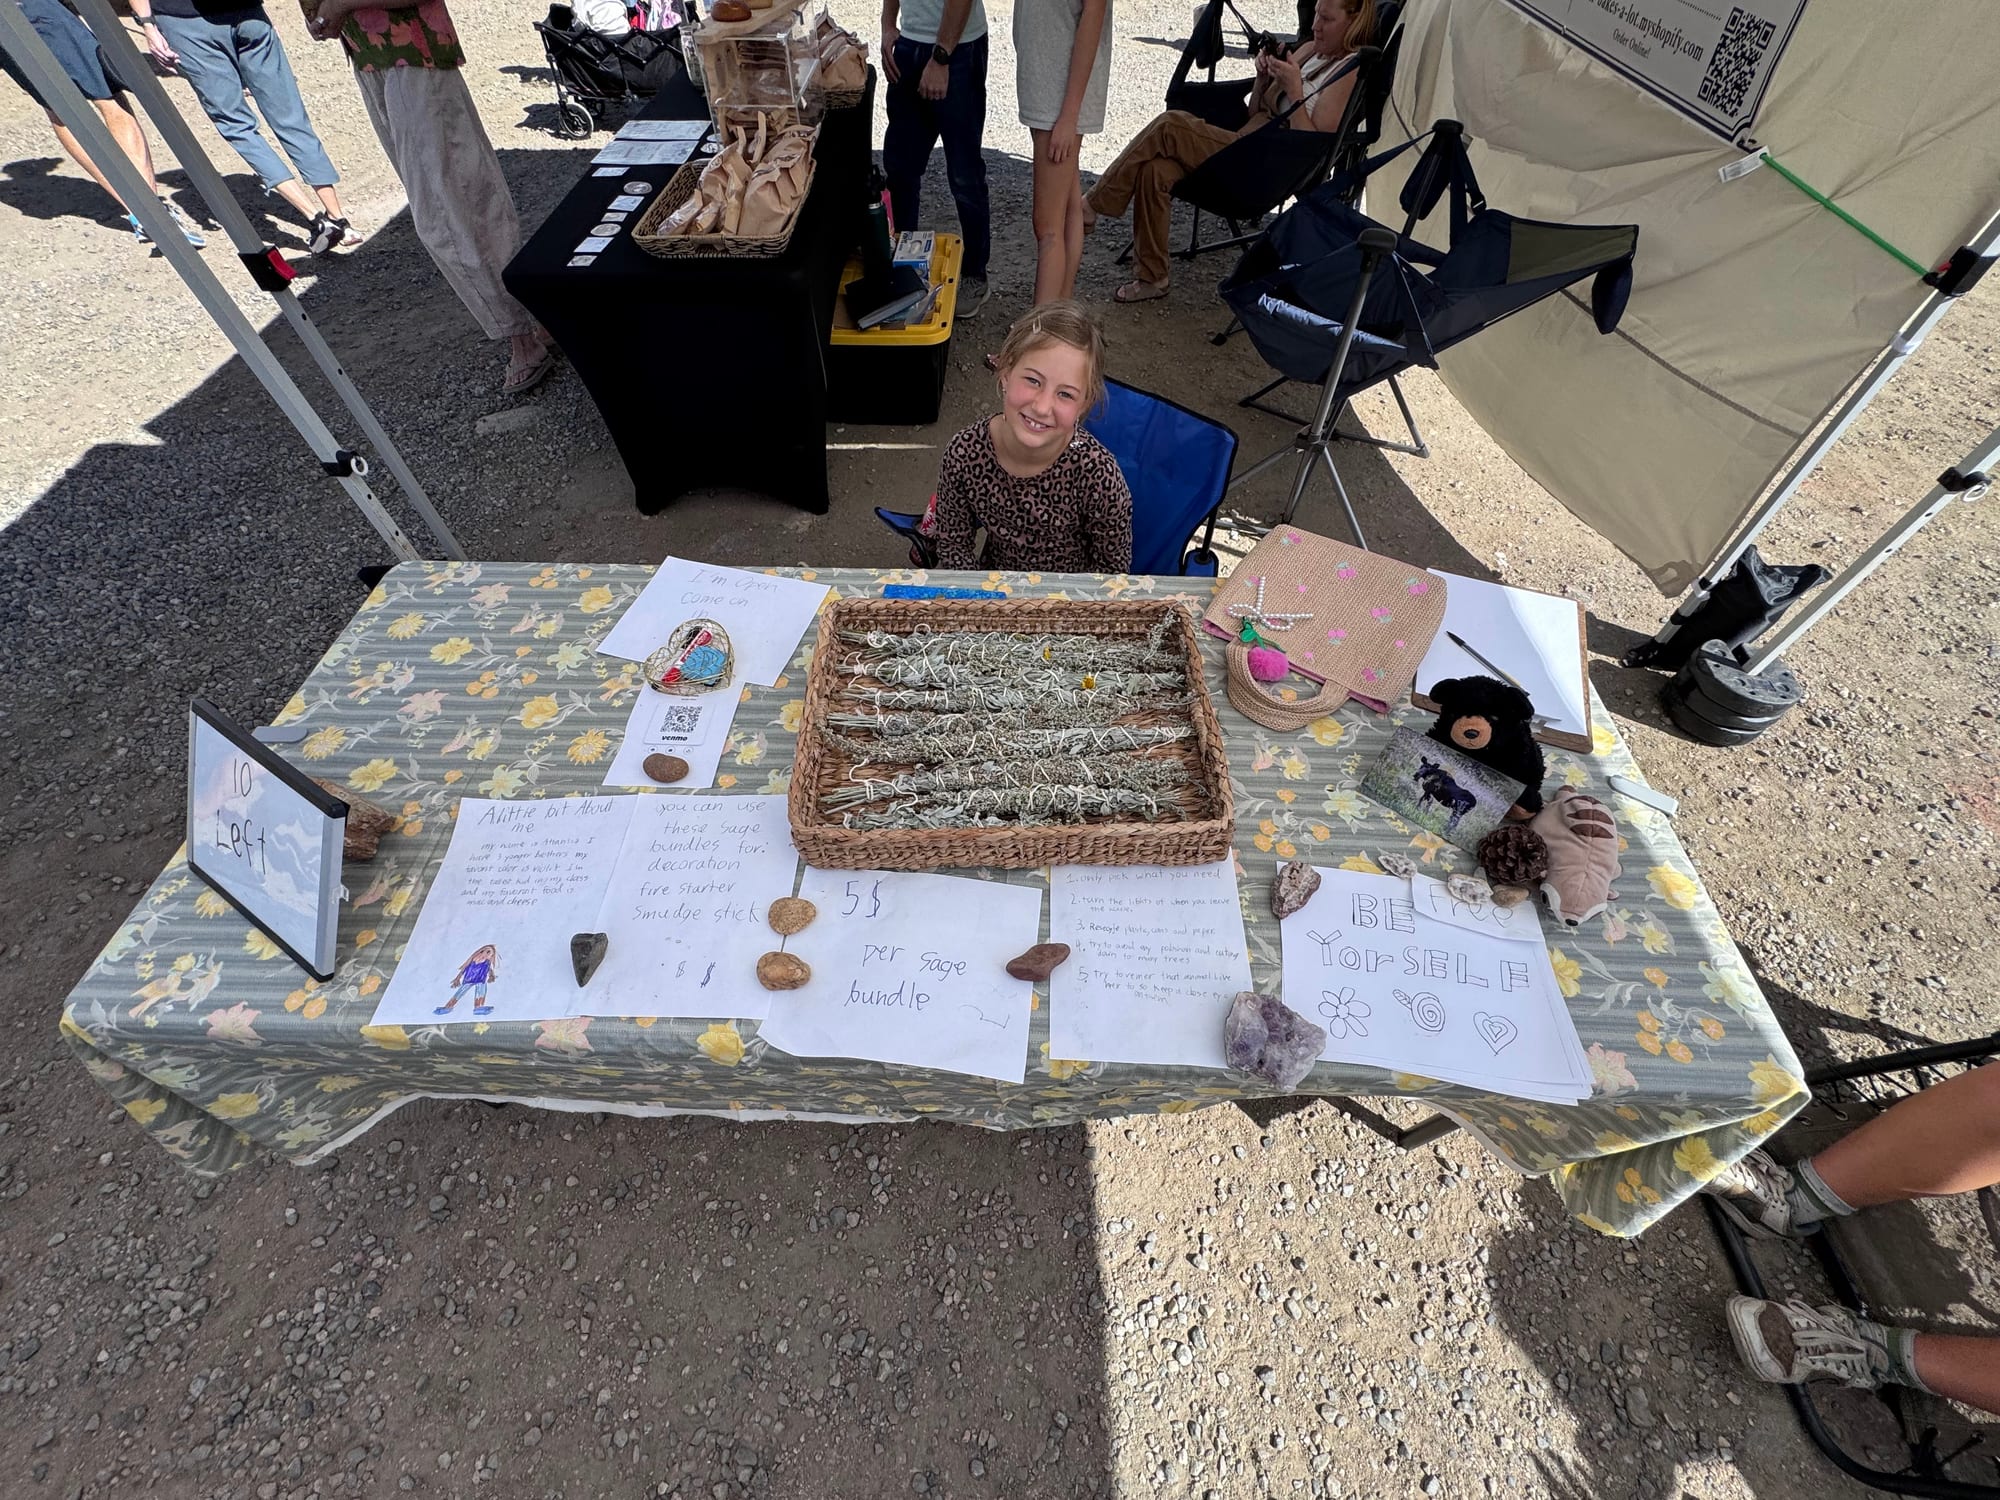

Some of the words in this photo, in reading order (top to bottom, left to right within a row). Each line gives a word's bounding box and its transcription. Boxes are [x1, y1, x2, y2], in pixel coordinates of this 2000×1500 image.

[1613, 28, 1629, 46] Order
[233, 757, 253, 798] 10
[693, 801, 724, 812] can
[737, 801, 767, 812] use
[511, 822, 535, 833] me
[663, 820, 709, 835] these
[650, 836, 721, 853] bundles
[647, 855, 741, 872] decoration
[1135, 868, 1164, 880] what
[1170, 870, 1189, 882] you
[1193, 868, 1221, 880] need
[639, 881, 671, 897] fire
[1109, 896, 1124, 906] the
[1192, 898, 1207, 908] you
[1352, 892, 1416, 934] BE
[1164, 955, 1191, 964] trees
[1161, 971, 1180, 981] that
[844, 979, 931, 1011] bundle
